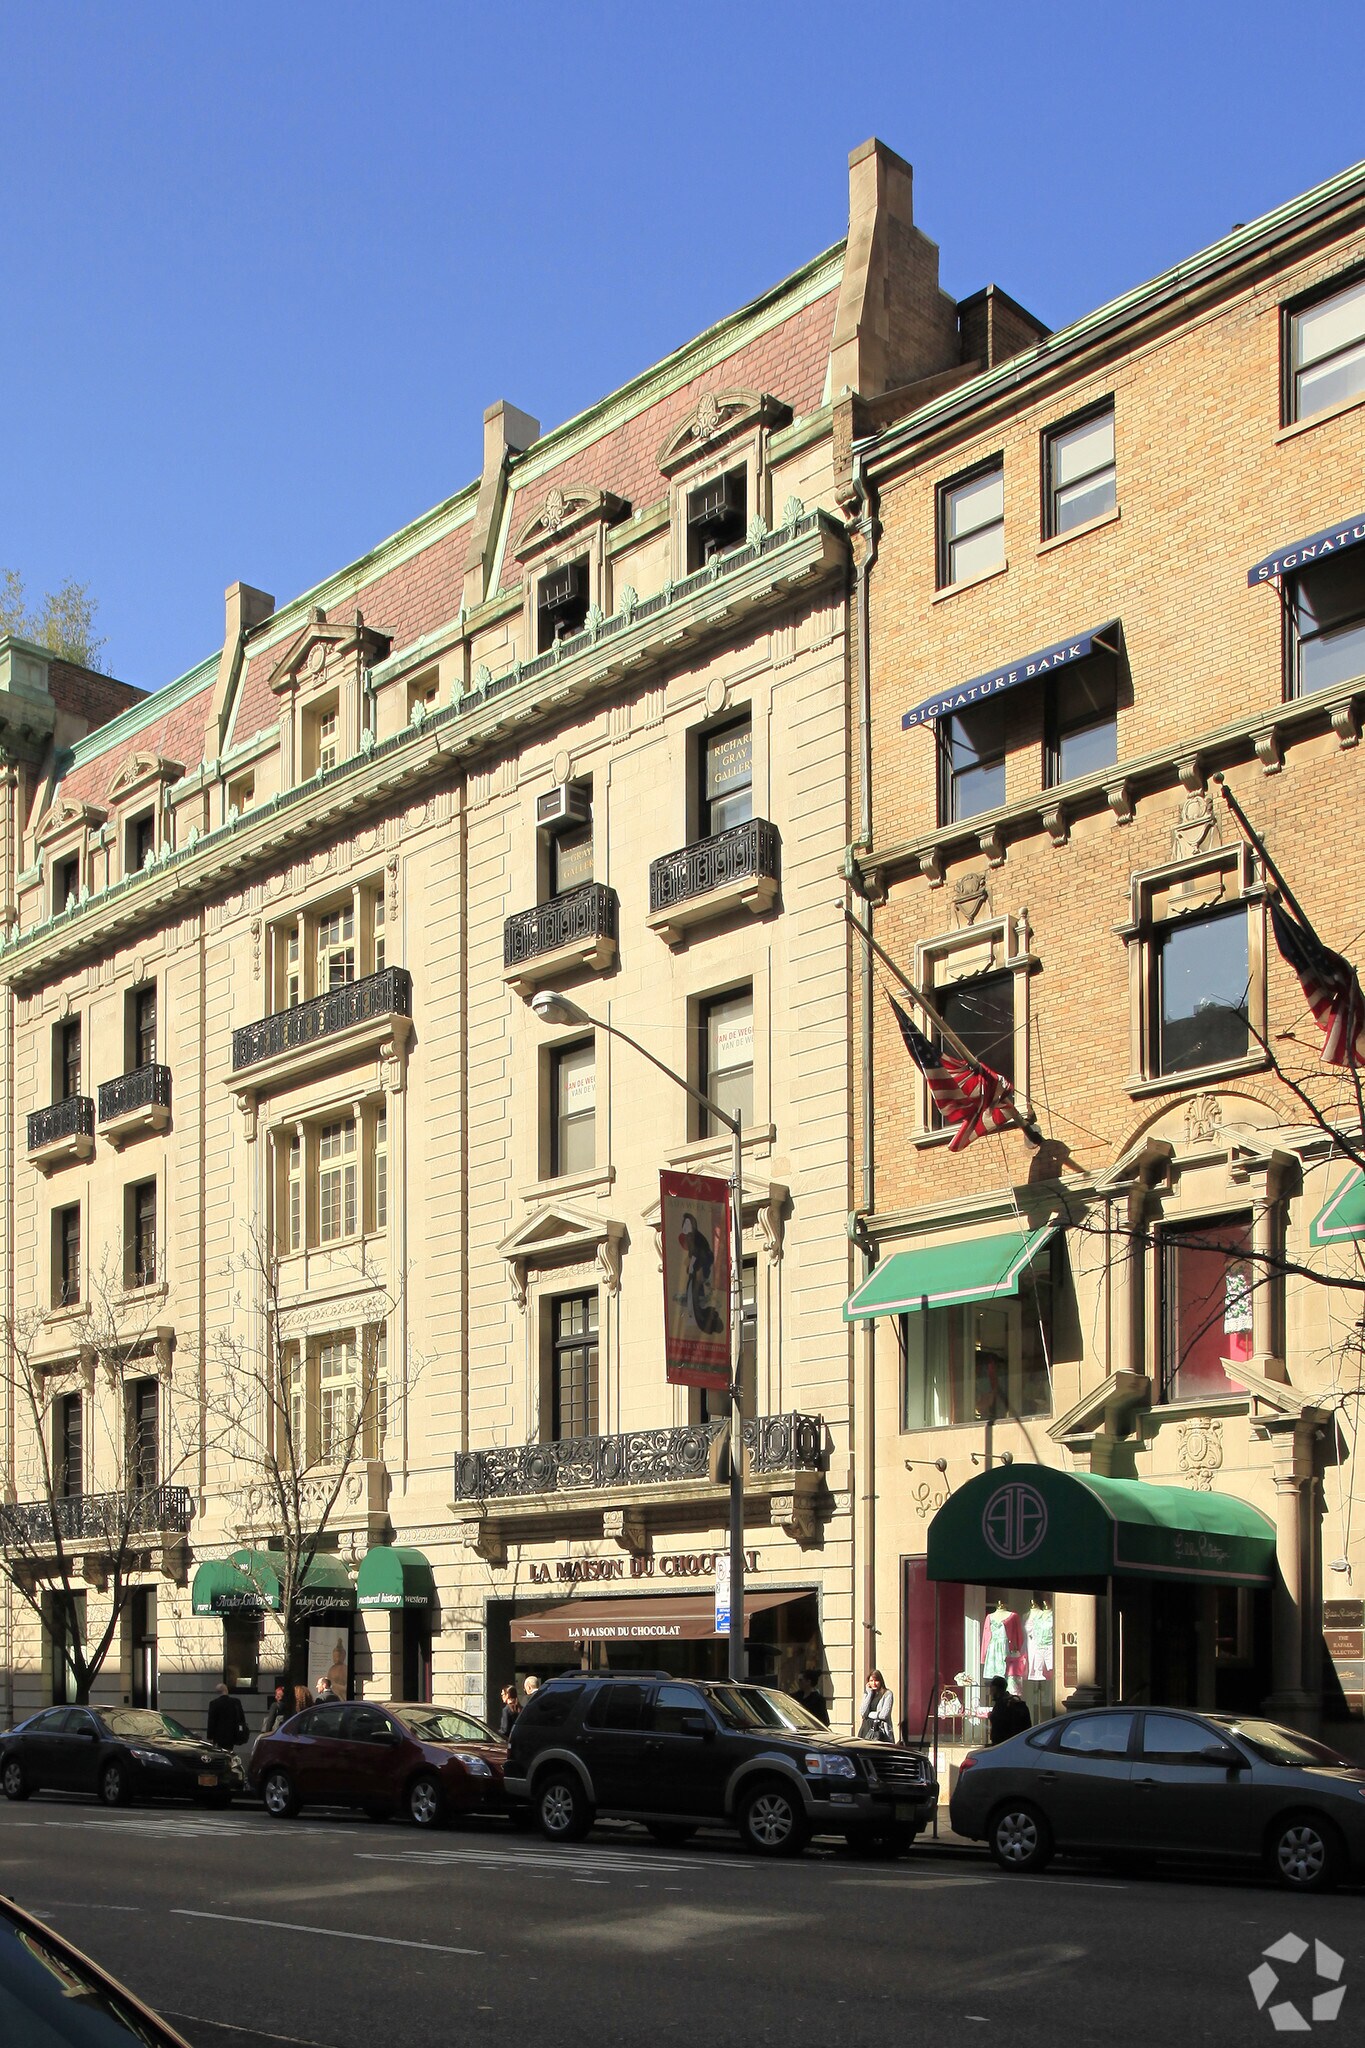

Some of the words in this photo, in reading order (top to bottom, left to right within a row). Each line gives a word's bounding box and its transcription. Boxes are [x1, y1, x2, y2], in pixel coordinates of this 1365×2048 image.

[1258, 524, 1365, 580] SIGNATU
[909, 672, 1018, 725] SIGNATURE
[1026, 645, 1081, 676] BANK
[722, 747, 748, 767] GRAY
[729, 1031, 737, 1040] DE
[736, 1037, 744, 1047] DE
[530, 1563, 552, 1583] LA
[556, 1558, 623, 1582] MAISON
[629, 1555, 654, 1578] DU
[315, 1595, 350, 1607] Galleries
[358, 1593, 381, 1604] natural
[381, 1592, 402, 1606] history
[568, 1627, 580, 1637] LA
[582, 1627, 616, 1637] MAISON
[617, 1626, 630, 1636] DU
[630, 1625, 681, 1636] CHOCOLAT
